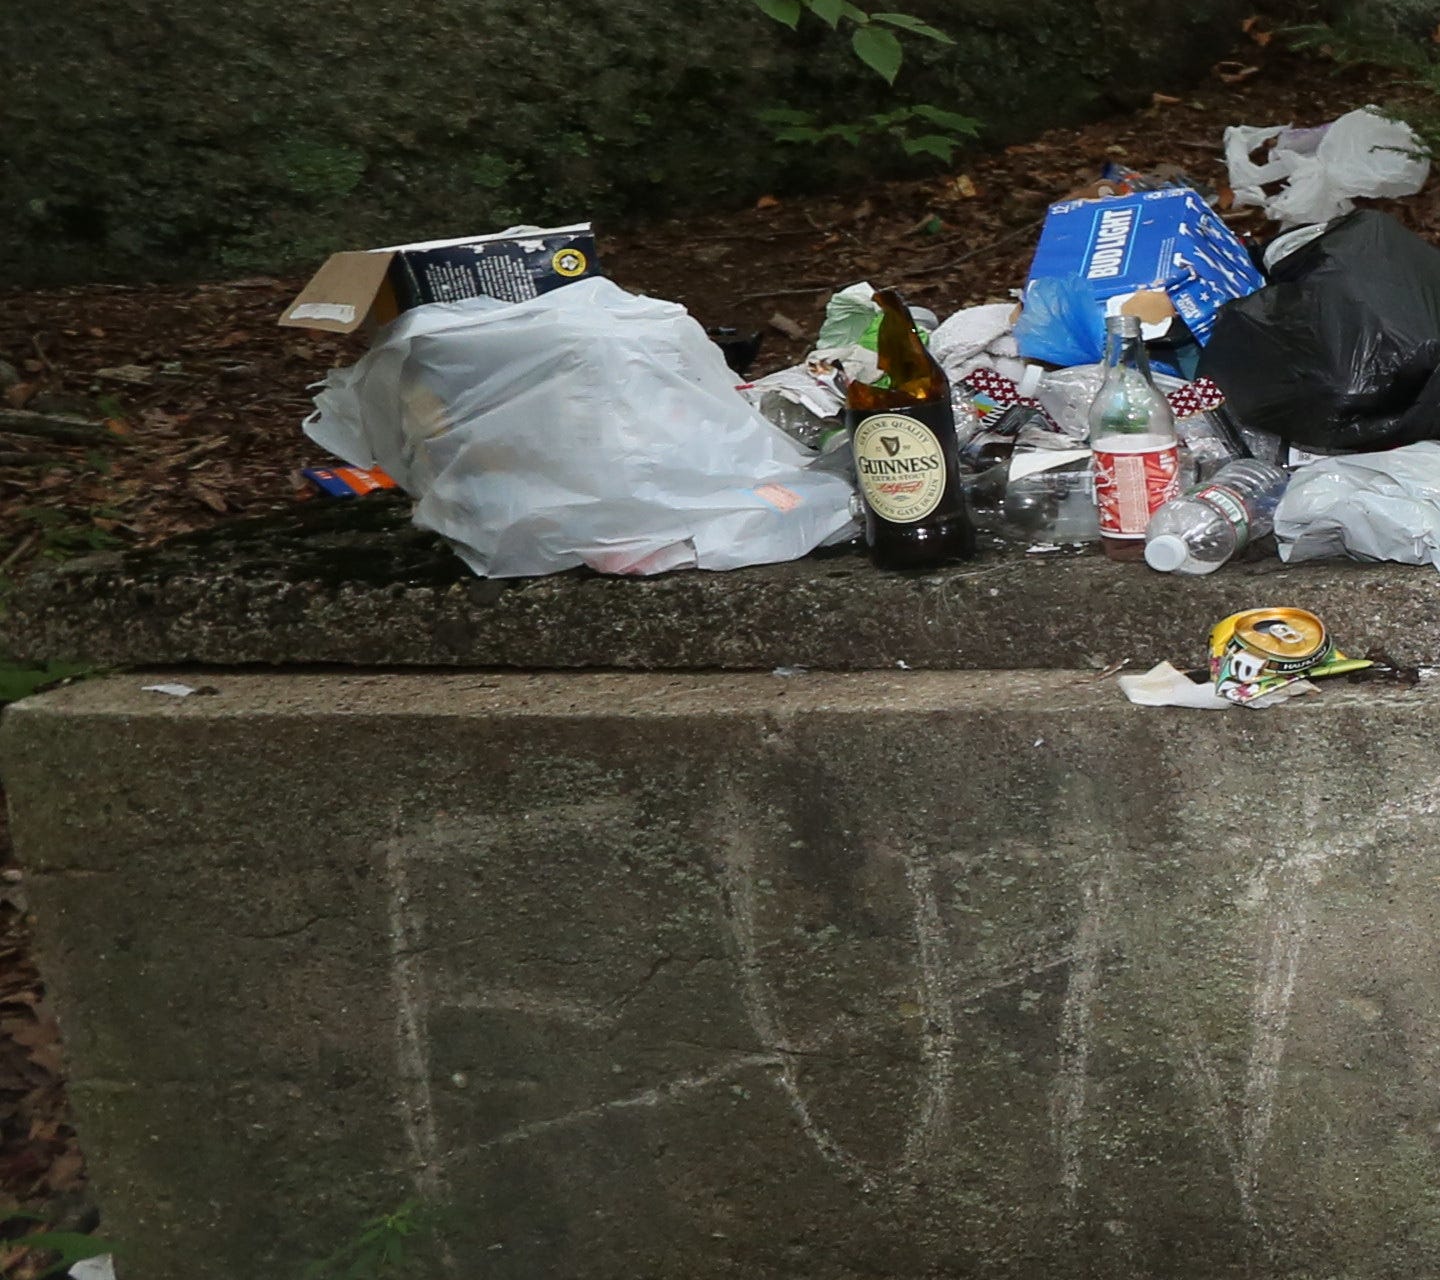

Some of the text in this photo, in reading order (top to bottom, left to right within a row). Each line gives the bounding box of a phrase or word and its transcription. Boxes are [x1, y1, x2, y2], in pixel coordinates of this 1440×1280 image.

[1088, 208, 1133, 279] BUD LIGHT
[858, 454, 939, 475] GUINNESS
